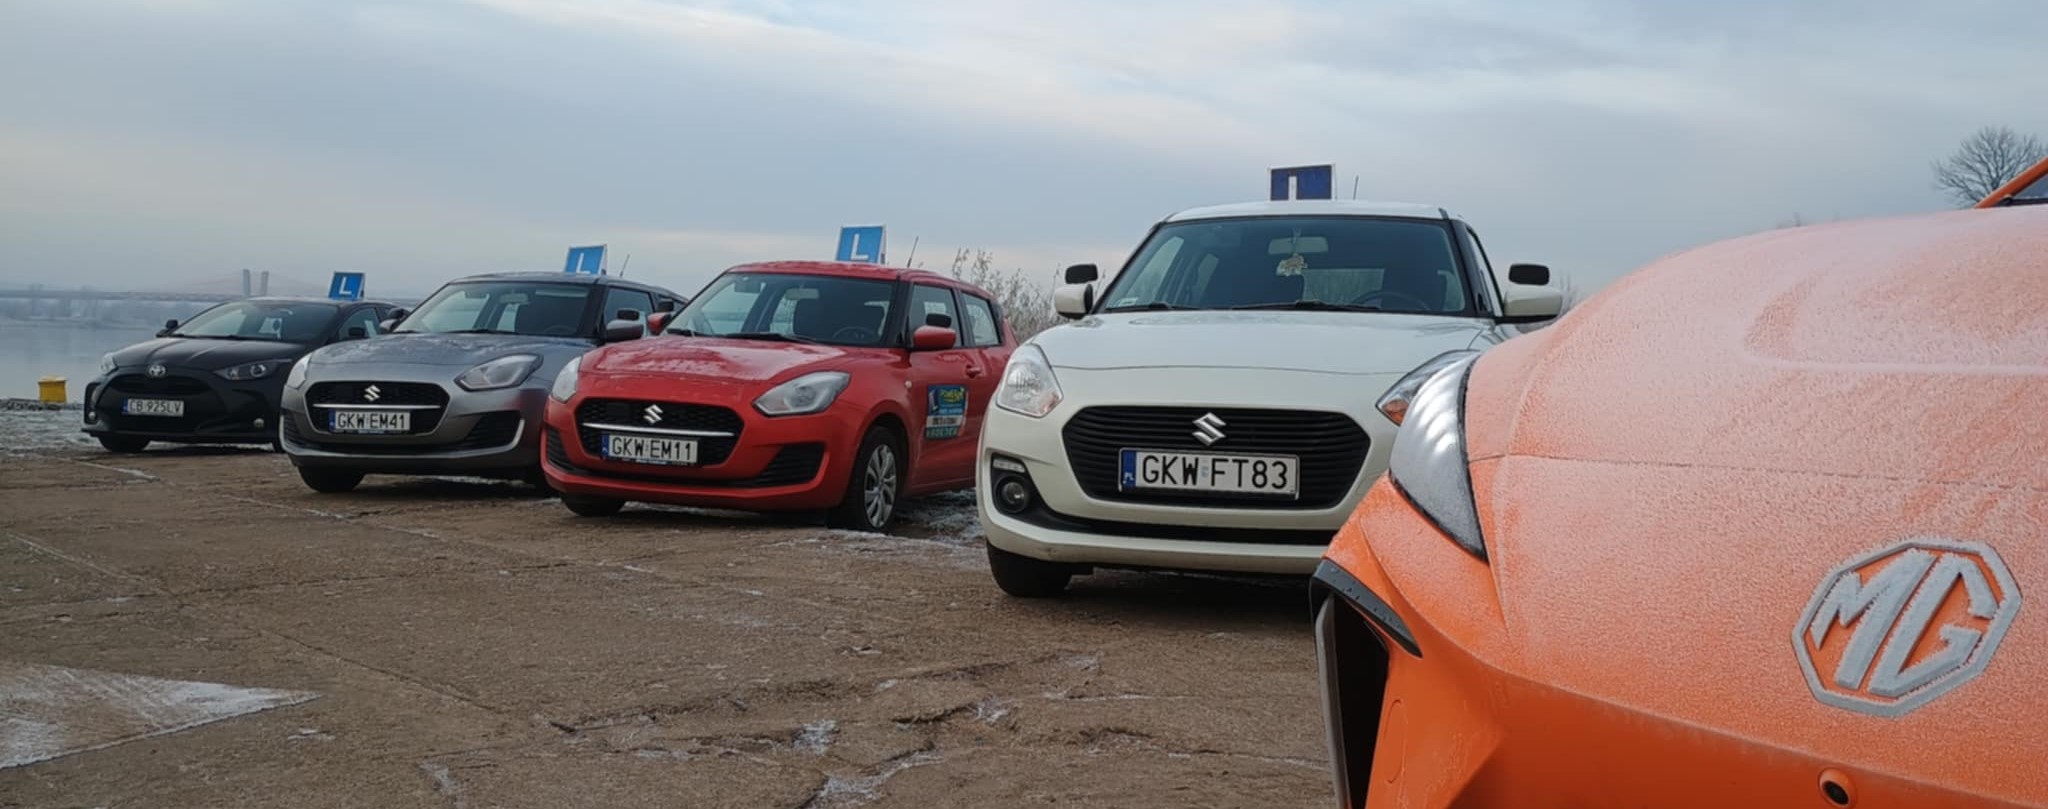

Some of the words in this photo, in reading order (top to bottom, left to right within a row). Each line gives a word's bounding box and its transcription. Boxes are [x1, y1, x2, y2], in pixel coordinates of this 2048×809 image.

[850, 233, 869, 260] L
[575, 252, 591, 274] L
[338, 276, 353, 295] L
[337, 412, 366, 429] GKW
[369, 413, 405, 429] EM41
[612, 437, 645, 457] GKW
[650, 440, 691, 461] EM11
[1142, 455, 1200, 486] GKW
[1210, 458, 1288, 490] FT83
[1809, 547, 2001, 699] MG
